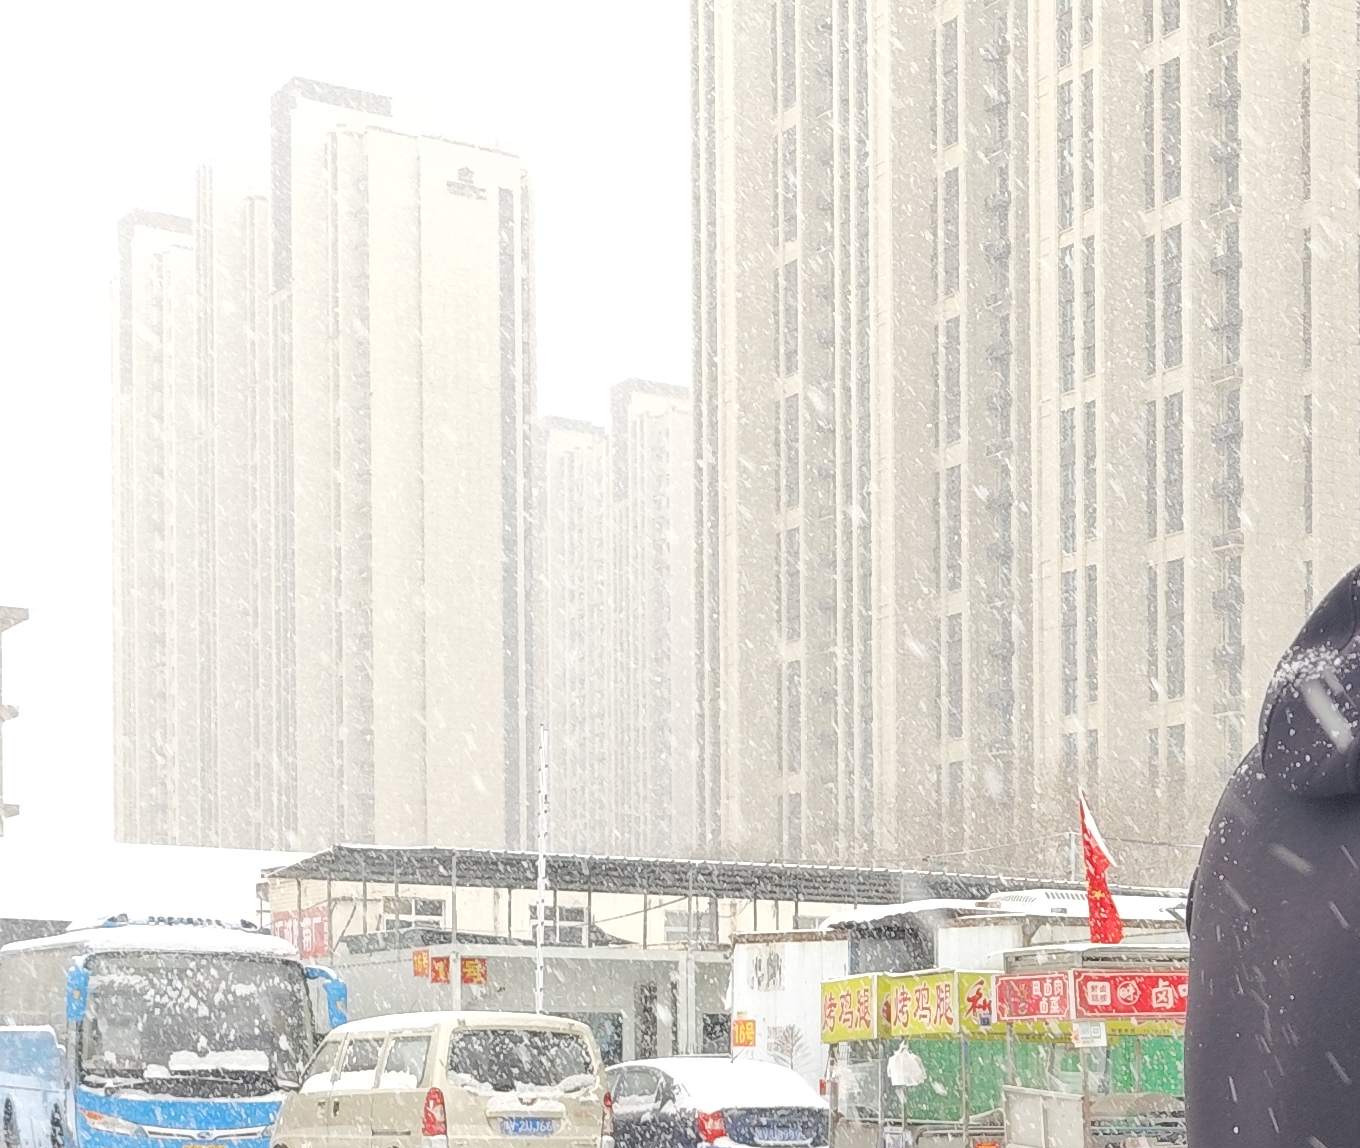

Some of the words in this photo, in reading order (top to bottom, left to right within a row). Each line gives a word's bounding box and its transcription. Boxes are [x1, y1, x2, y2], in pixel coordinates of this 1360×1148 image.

[822, 987, 872, 1033] 烤鸡腿
[893, 983, 954, 1028] 烤鸡腿
